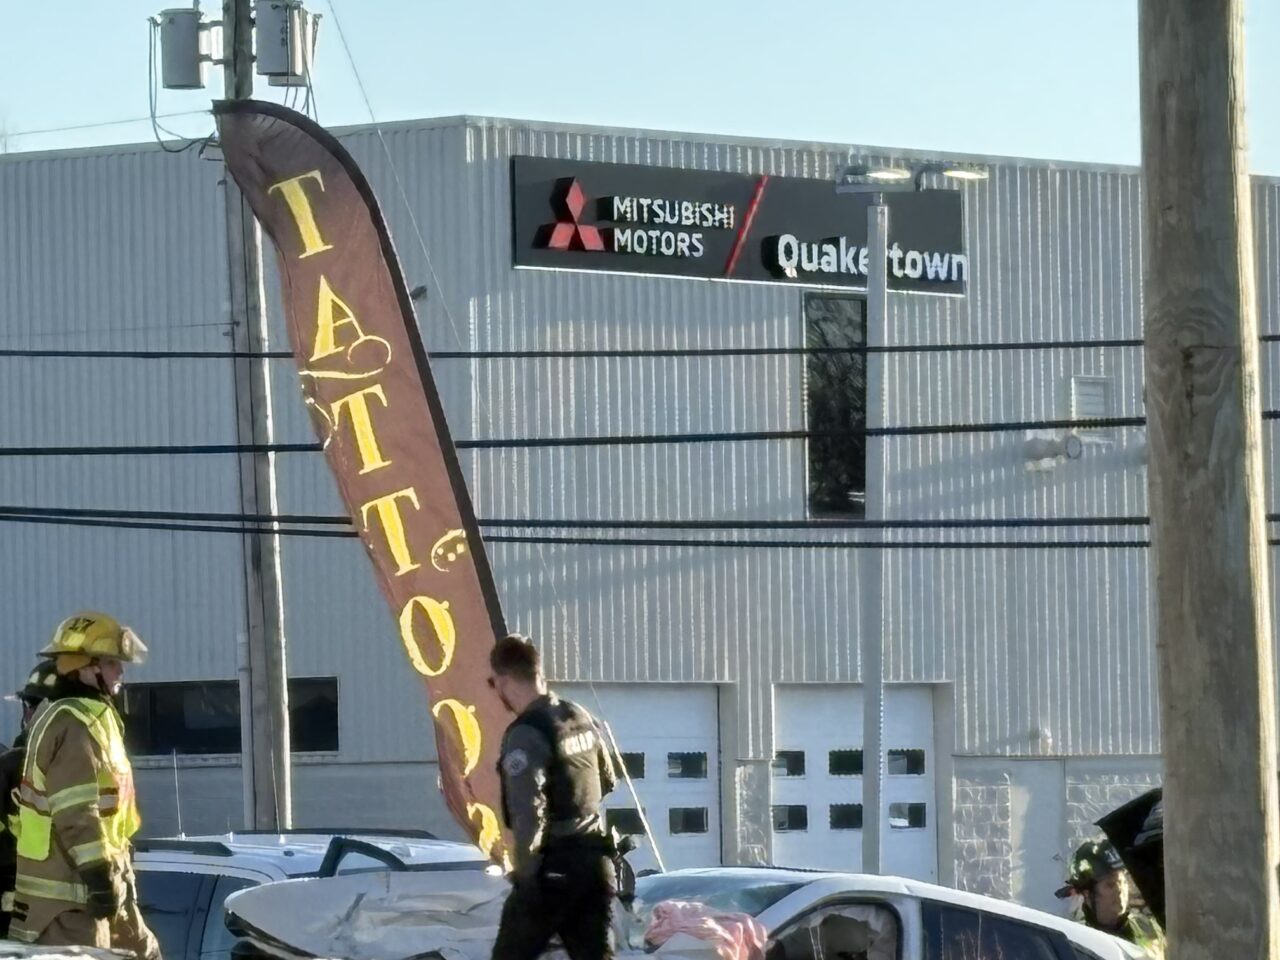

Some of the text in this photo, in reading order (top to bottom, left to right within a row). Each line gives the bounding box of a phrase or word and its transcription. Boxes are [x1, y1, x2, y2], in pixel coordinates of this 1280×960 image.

[612, 195, 735, 230] MITSUBISHI
[613, 227, 704, 258] MOTORS
[777, 233, 968, 281] Quaketown
